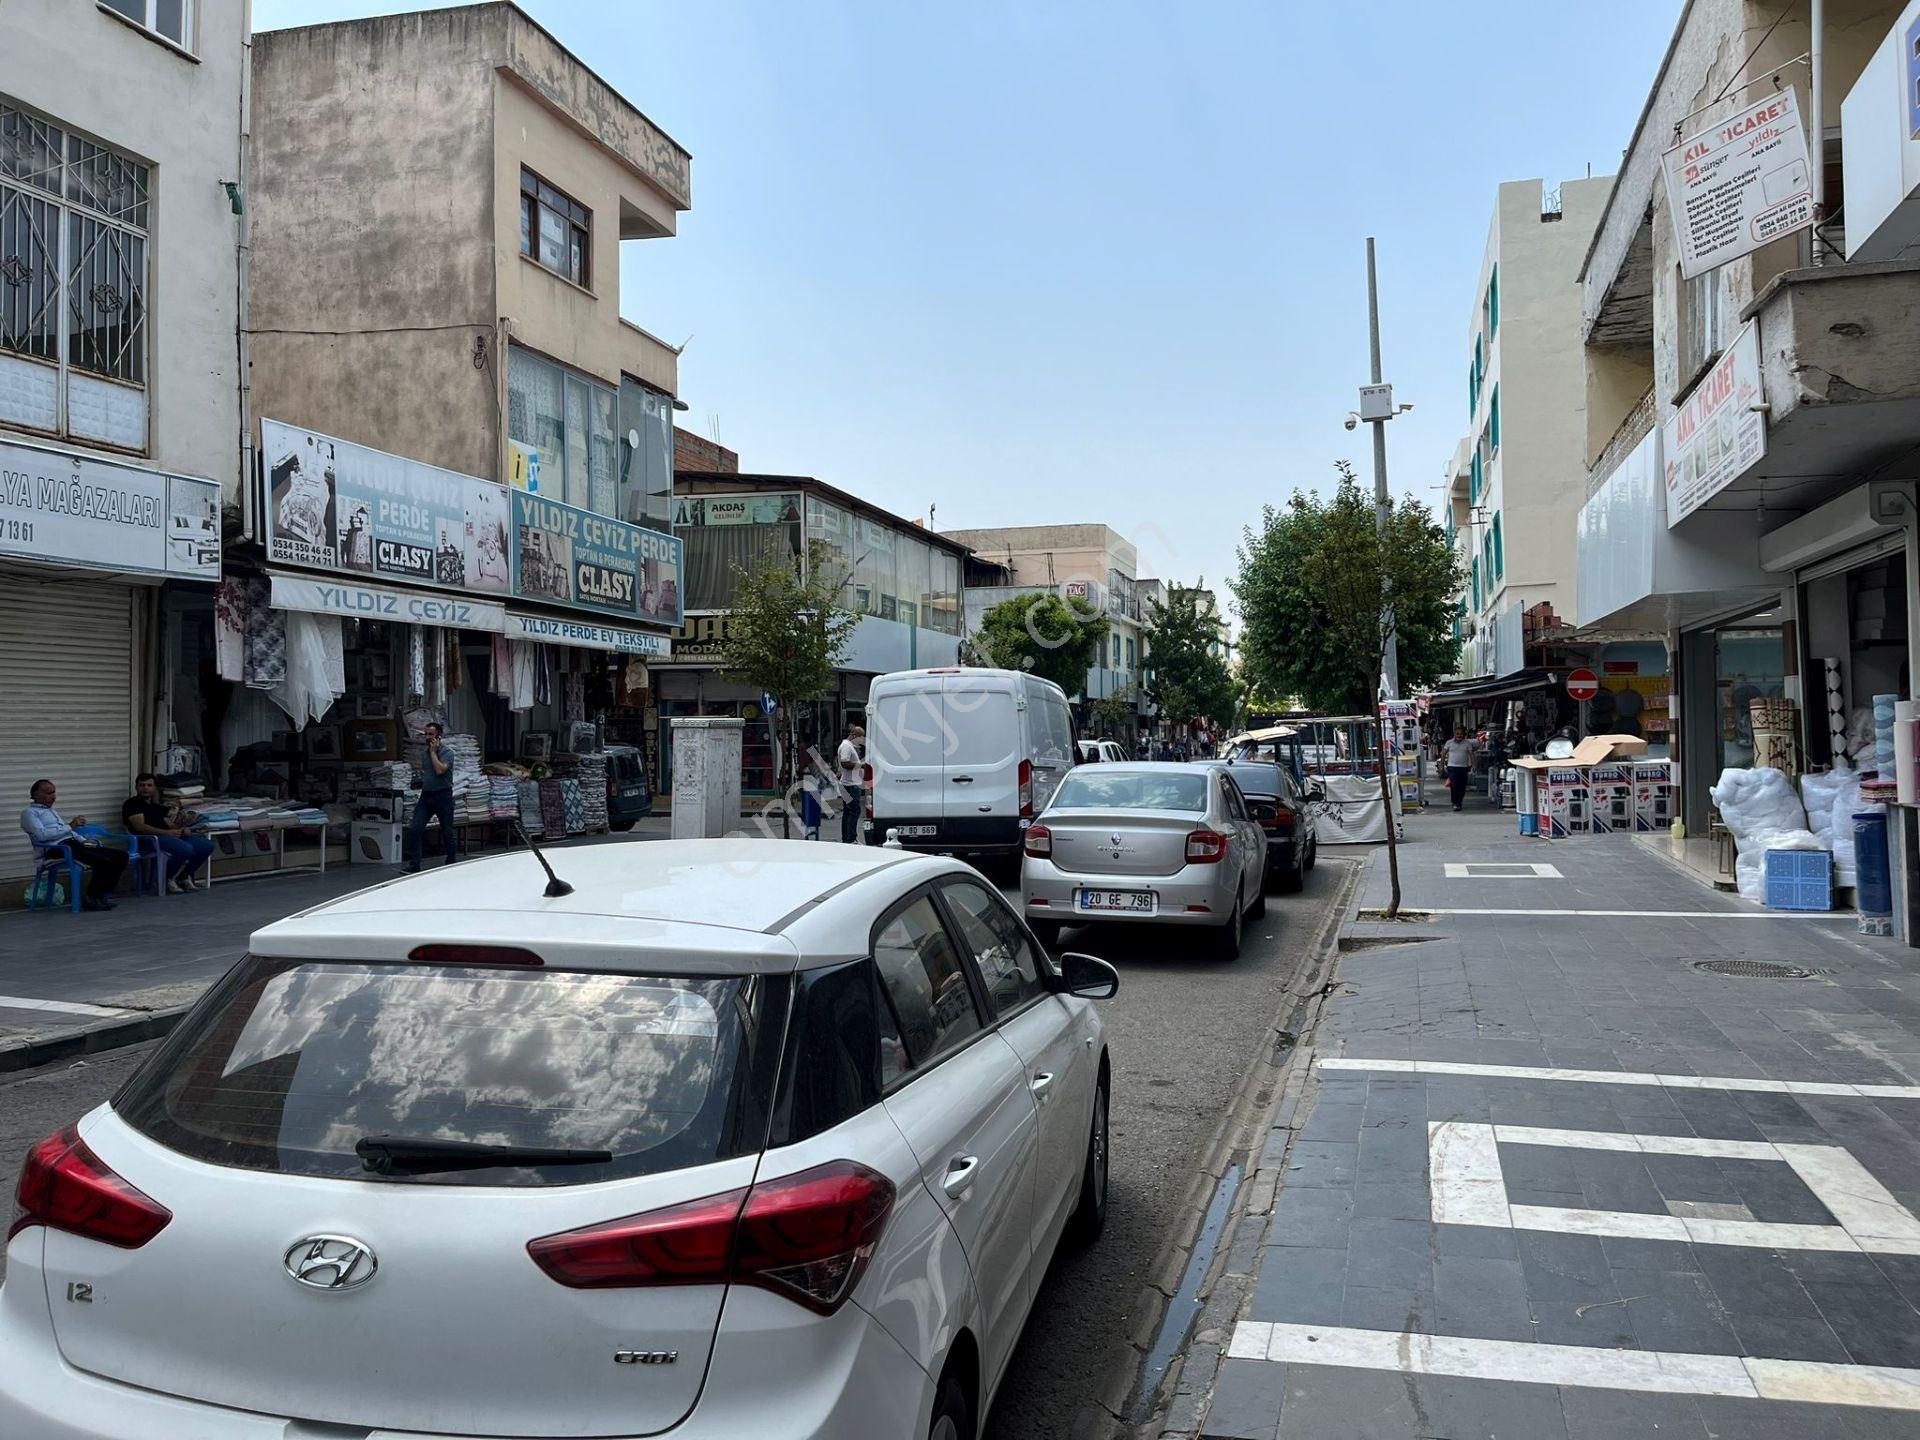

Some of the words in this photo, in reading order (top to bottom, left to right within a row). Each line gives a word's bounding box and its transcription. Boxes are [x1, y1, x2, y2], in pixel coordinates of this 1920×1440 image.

[37, 473, 161, 529] MAĞAZALARI
[378, 499, 430, 532] PERDE
[711, 502, 746, 513] AKDAŞ
[8, 520, 20, 540] 13
[22, 522, 34, 542] 61
[519, 497, 579, 539] YILDIZ
[582, 517, 628, 551] ÇEYİZ
[630, 530, 677, 565] PERDE
[378, 541, 431, 571] CLASY
[578, 563, 634, 601] CLASY
[315, 585, 399, 615] YILDIZ
[407, 598, 472, 623] ÇEYİZ
[519, 617, 560, 637] YILDIZ
[562, 622, 598, 641] PERDE
[600, 628, 615, 644] EV
[1089, 893, 1102, 905] 20
[1108, 894, 1122, 906] GE
[1130, 895, 1150, 907] 796
